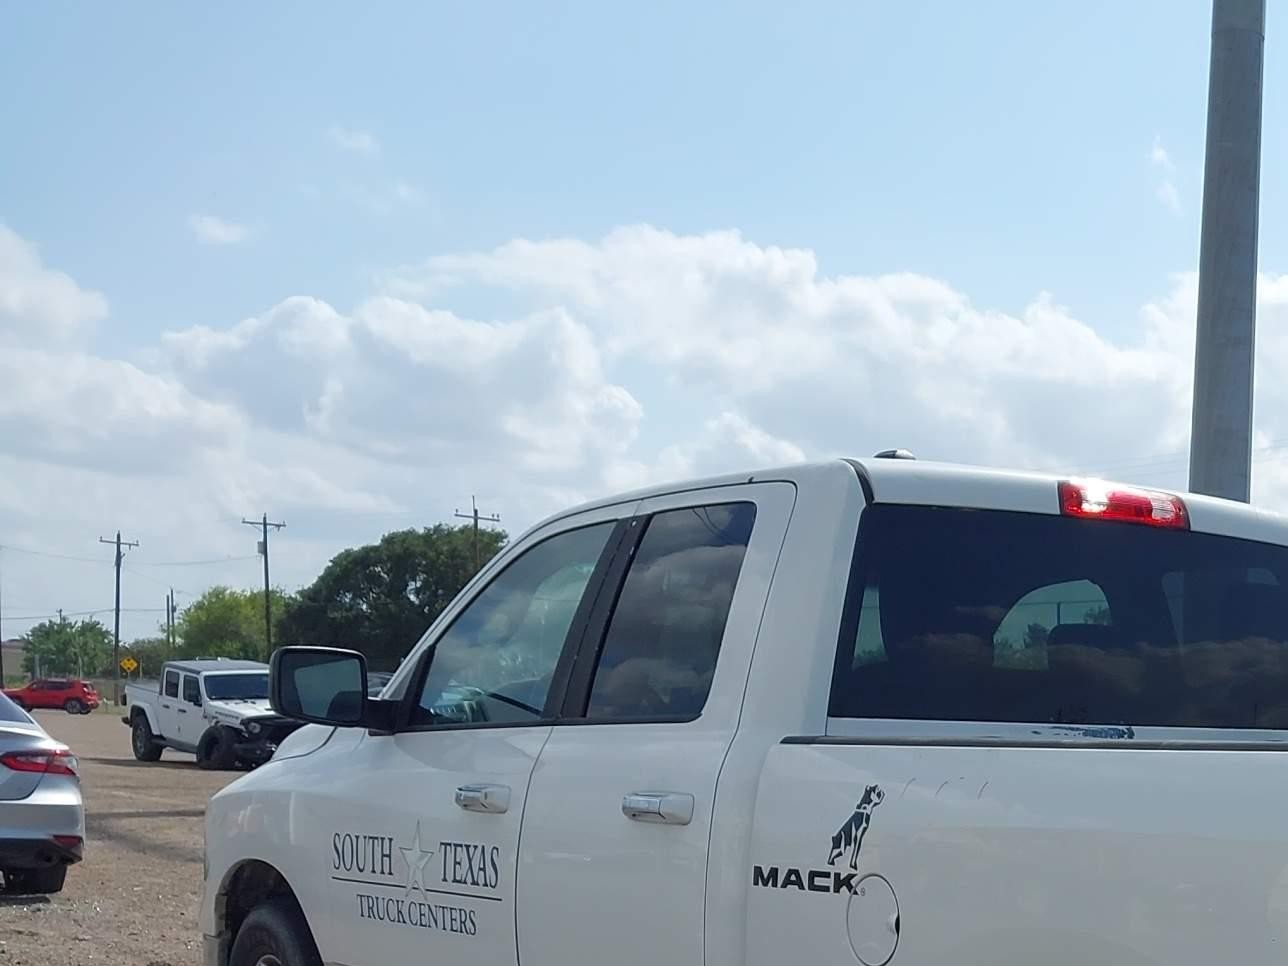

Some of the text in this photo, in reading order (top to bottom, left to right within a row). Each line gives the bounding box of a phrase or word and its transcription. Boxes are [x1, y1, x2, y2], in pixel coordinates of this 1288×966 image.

[333, 832, 500, 889] SOUTH TEXAS
[752, 865, 859, 896] MACK
[356, 893, 477, 936] TRUCK CENTERS
